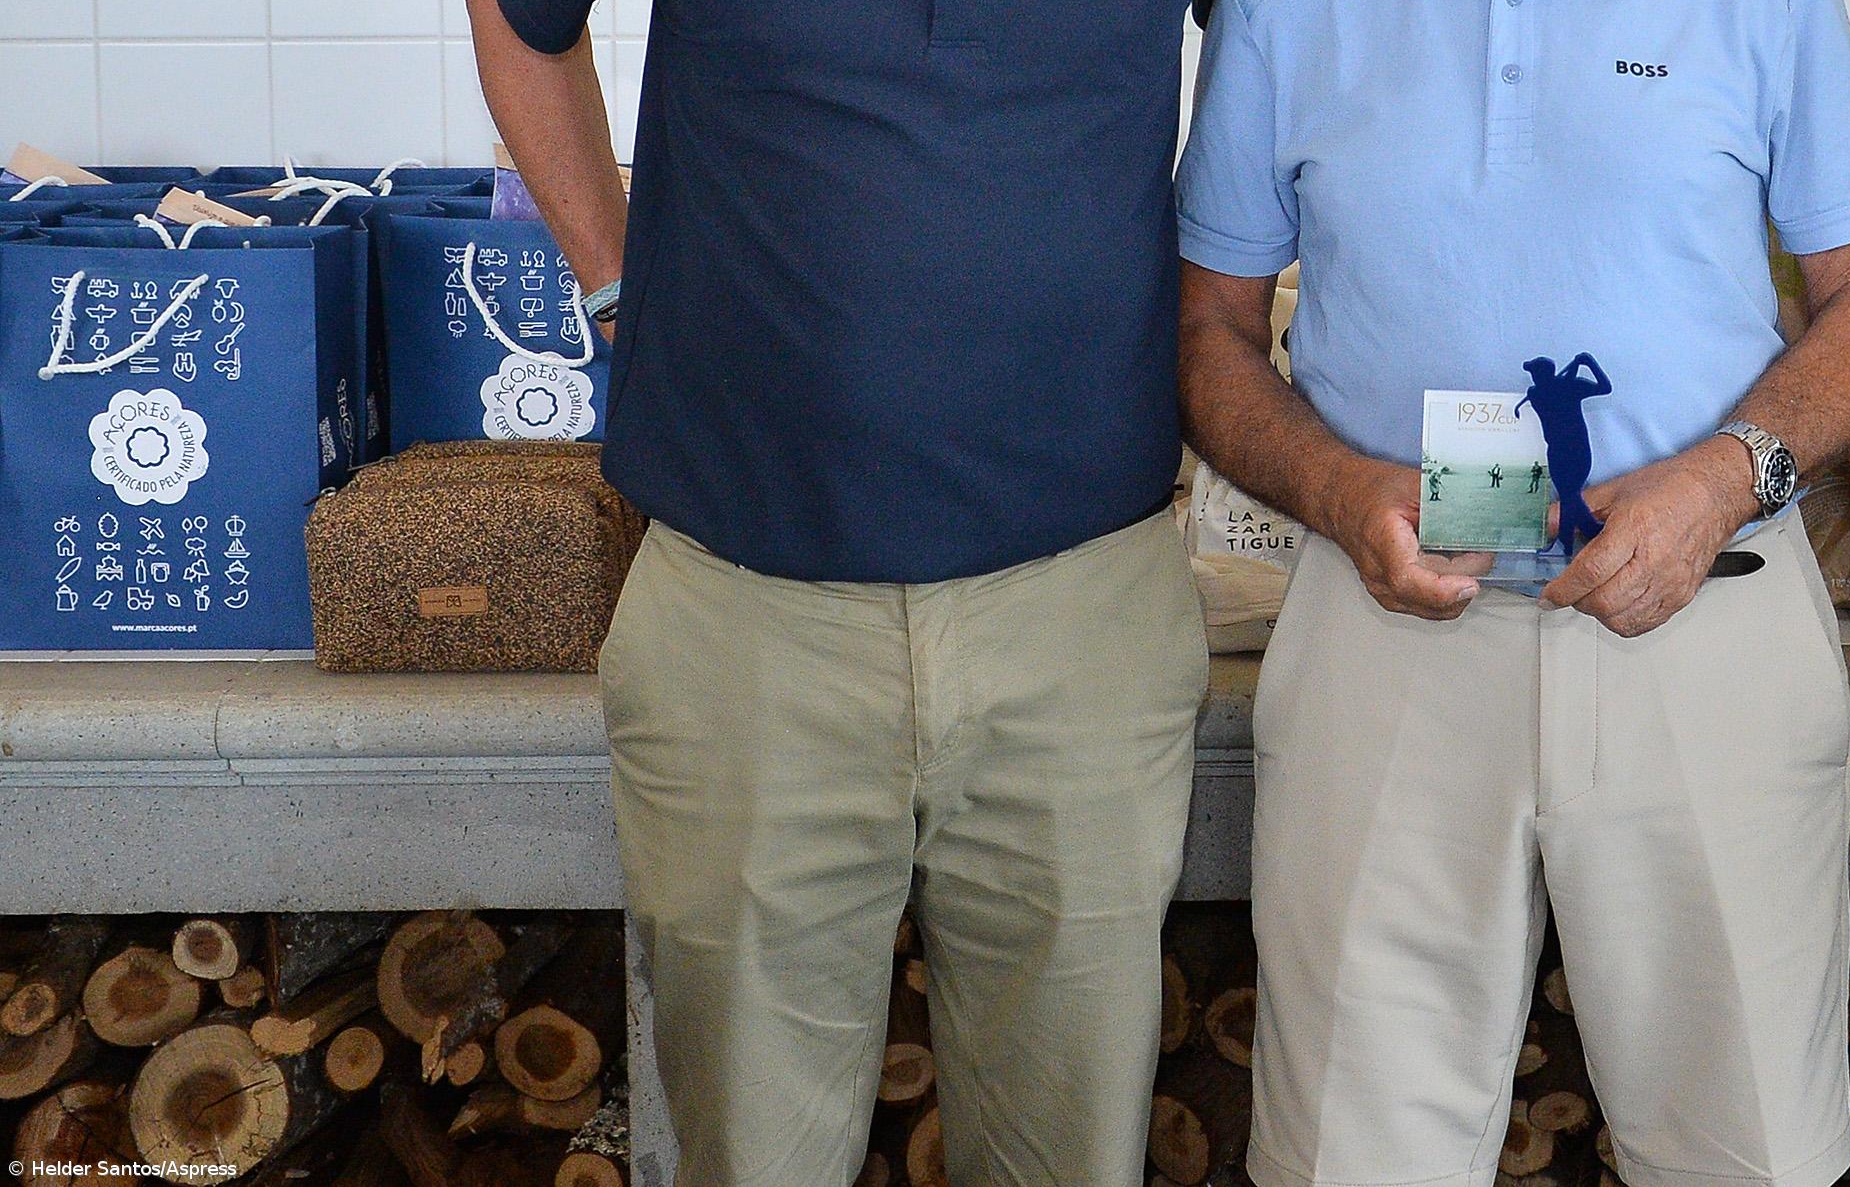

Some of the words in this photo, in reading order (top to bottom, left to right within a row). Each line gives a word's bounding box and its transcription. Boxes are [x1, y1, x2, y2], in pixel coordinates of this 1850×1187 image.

[1615, 60, 1669, 78] BOSS
[494, 364, 558, 406] AÇORES
[565, 380, 582, 429] NATUREZA
[1457, 402, 1502, 424] 1937
[103, 401, 170, 445] AÇORES
[103, 455, 158, 493] CERTIFICADO
[159, 471, 185, 491] PELA
[177, 421, 196, 473] NATUREZA
[1229, 511, 1254, 522] LA
[1227, 523, 1271, 534] ZAR
[1226, 537, 1294, 551] TIGUE
[111, 624, 198, 633] www.marcaacores.pt
